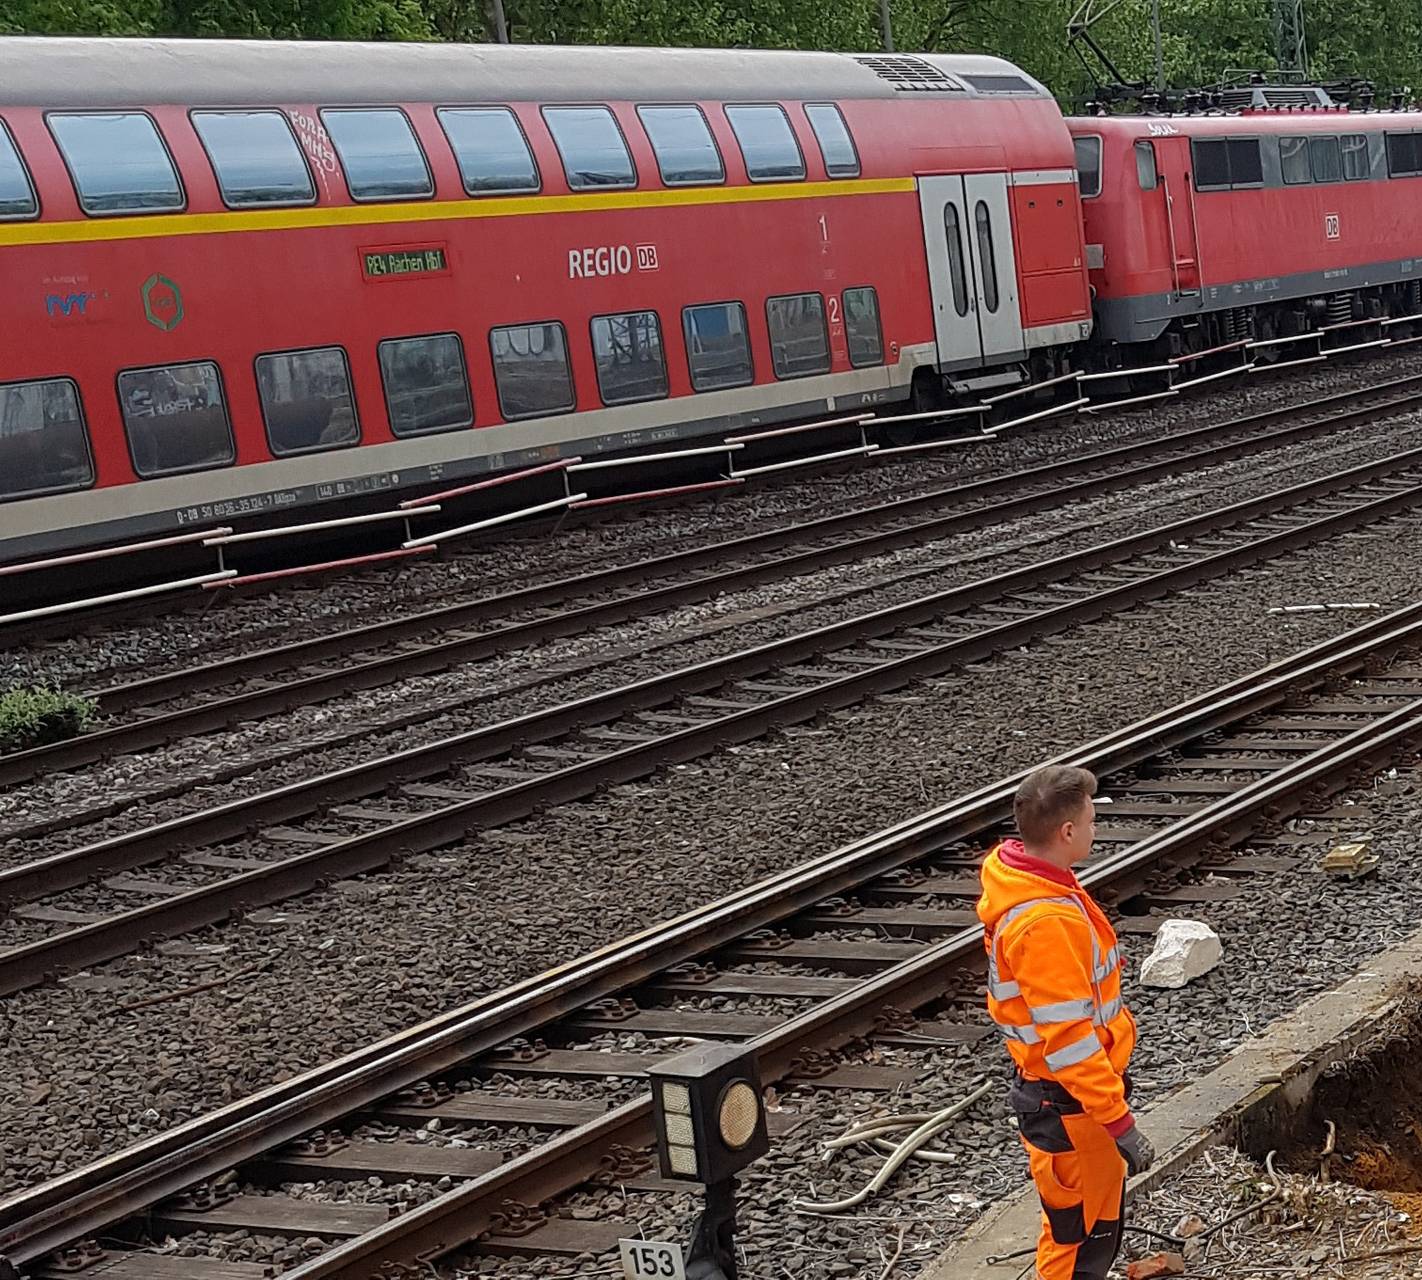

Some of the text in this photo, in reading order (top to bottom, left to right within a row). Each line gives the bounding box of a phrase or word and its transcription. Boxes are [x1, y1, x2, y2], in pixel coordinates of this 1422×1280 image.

[818, 215, 828, 241] 1
[1326, 216, 1339, 237] DB
[388, 253, 425, 273] Aachen
[569, 245, 657, 278] REGIO DB
[829, 298, 840, 323] 2
[628, 1247, 676, 1277] 153
